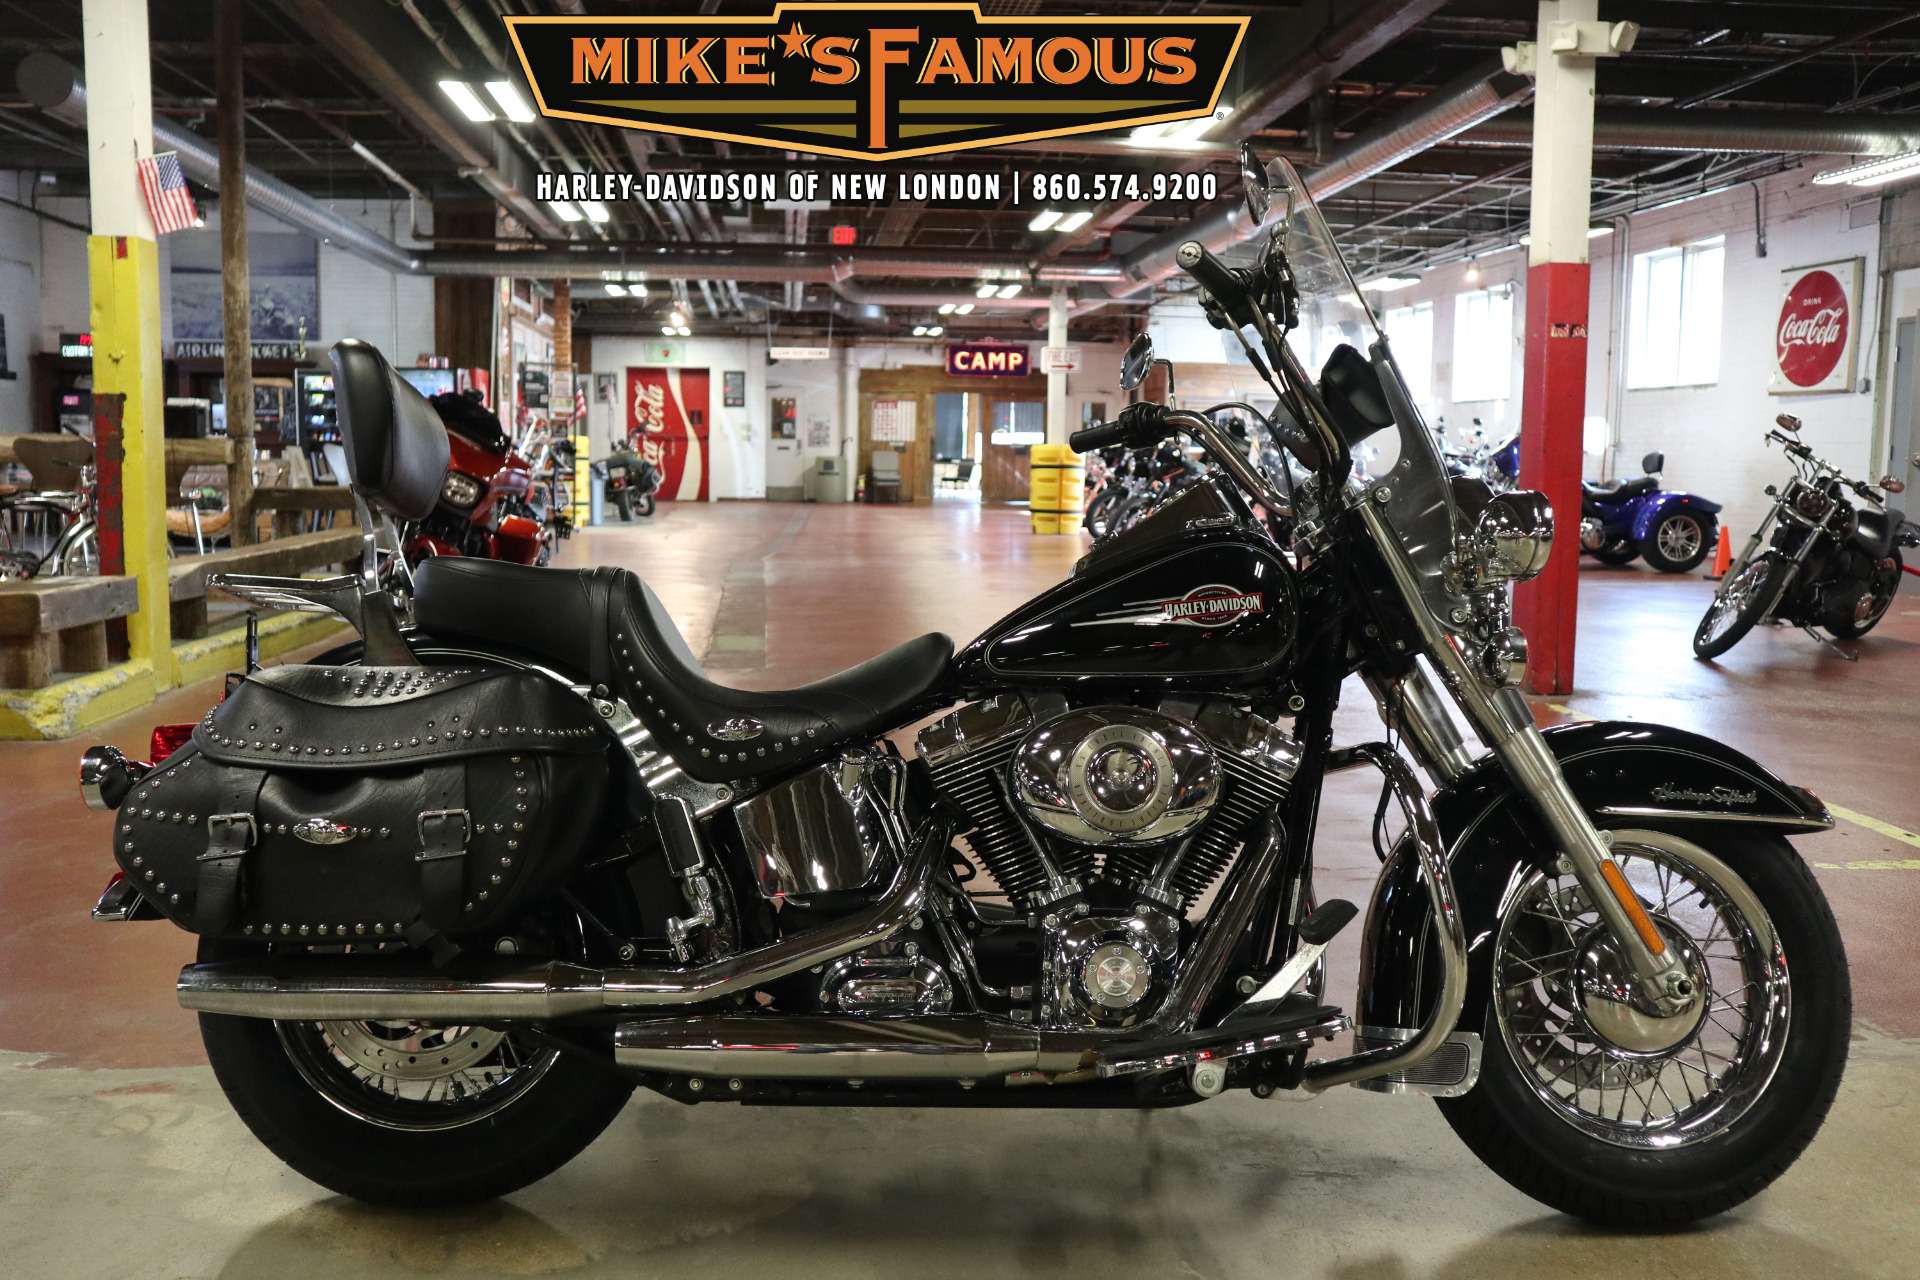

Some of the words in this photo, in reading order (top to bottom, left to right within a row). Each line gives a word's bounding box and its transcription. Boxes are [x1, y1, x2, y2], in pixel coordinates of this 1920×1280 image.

[1803, 297, 1822, 306] DRINK
[1779, 307, 1844, 347] Coca-Cola
[62, 345, 89, 357] CUSTOM
[176, 342, 225, 359] AIRLIN
[953, 350, 1024, 371] CAMP
[1164, 594, 1261, 618] HARLEY-DAVIDSON
